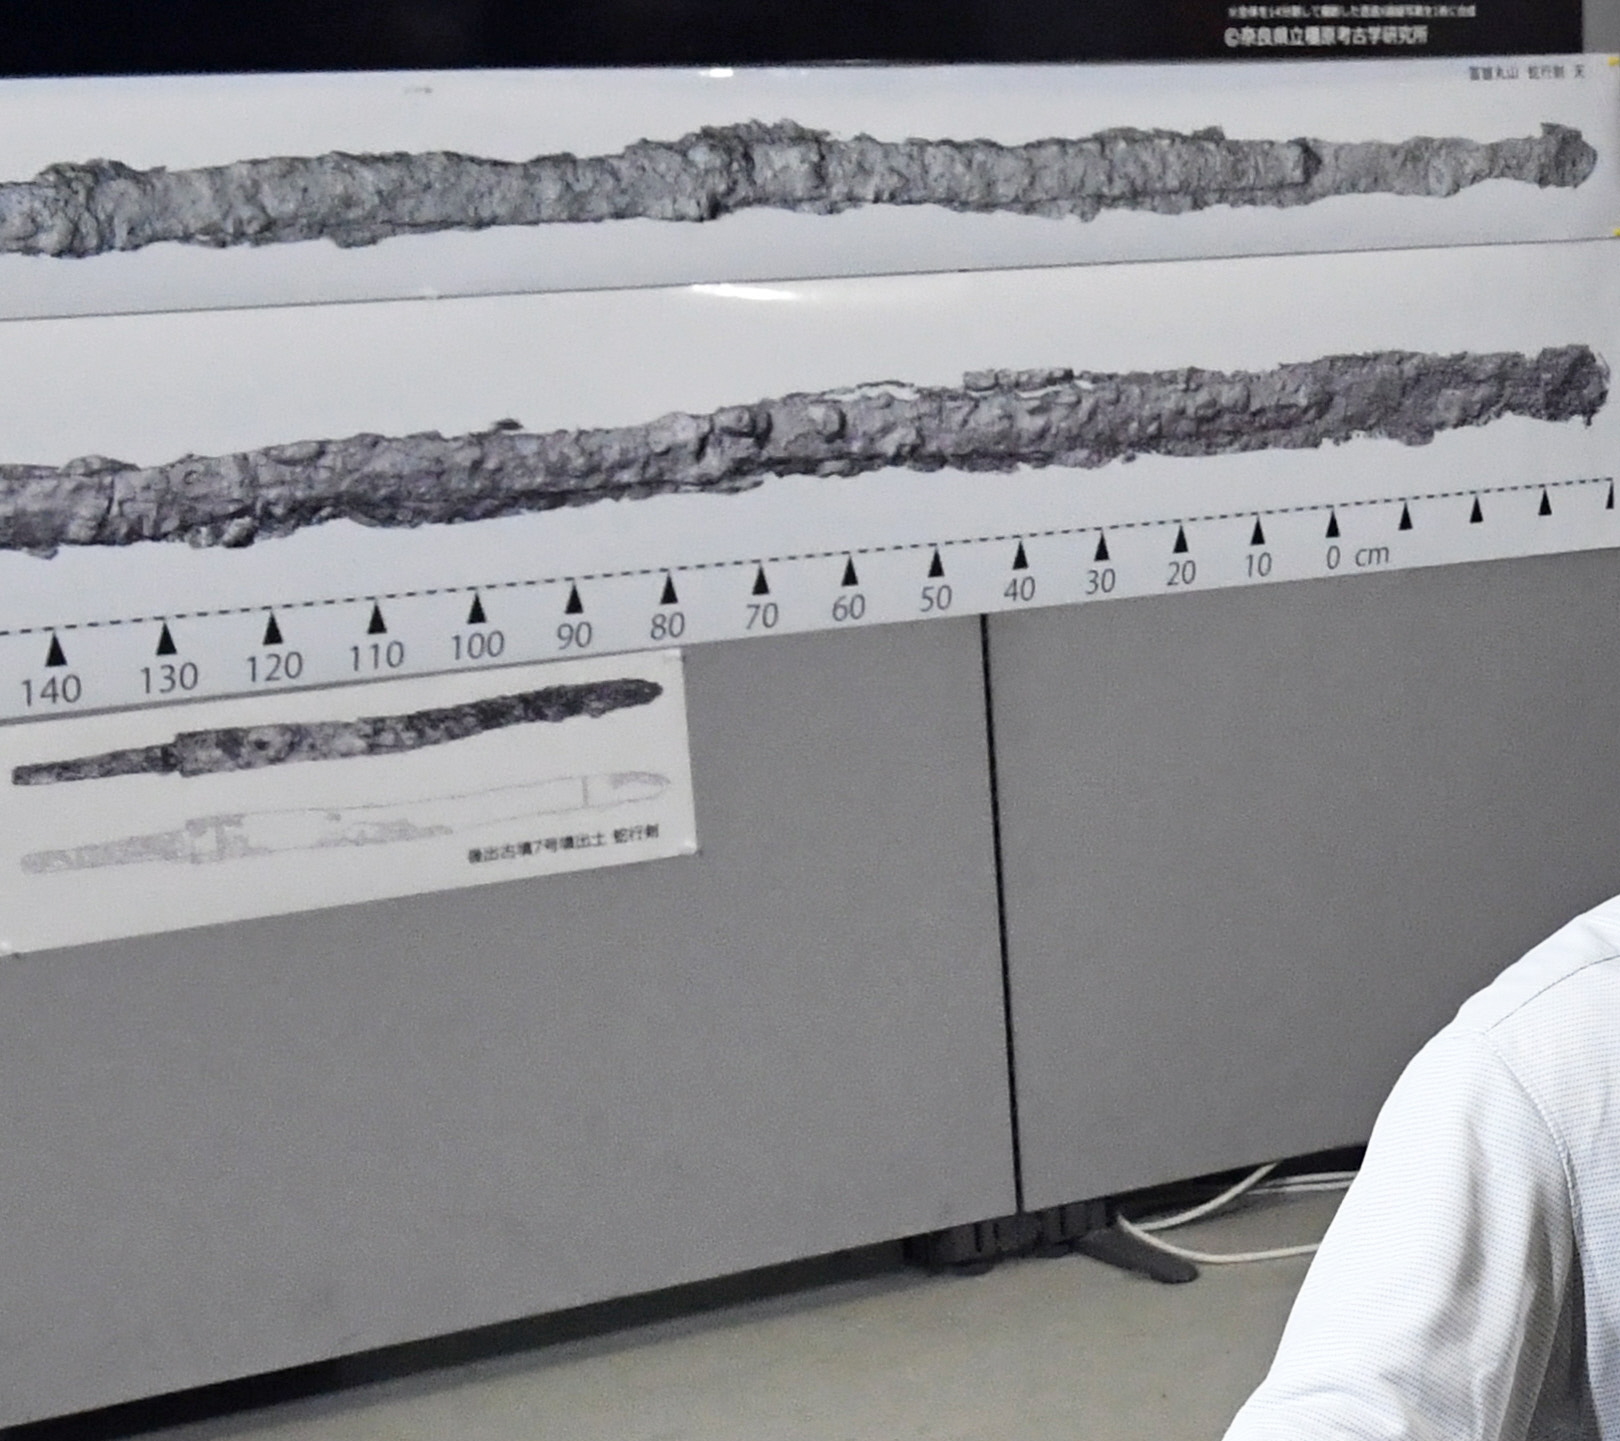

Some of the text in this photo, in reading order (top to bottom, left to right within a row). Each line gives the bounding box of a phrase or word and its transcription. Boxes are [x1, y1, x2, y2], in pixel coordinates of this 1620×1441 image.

[20, 544, 1391, 708] 140 130 120 110 100 90 80 70 60 50 40 30 20 10 0 cm
